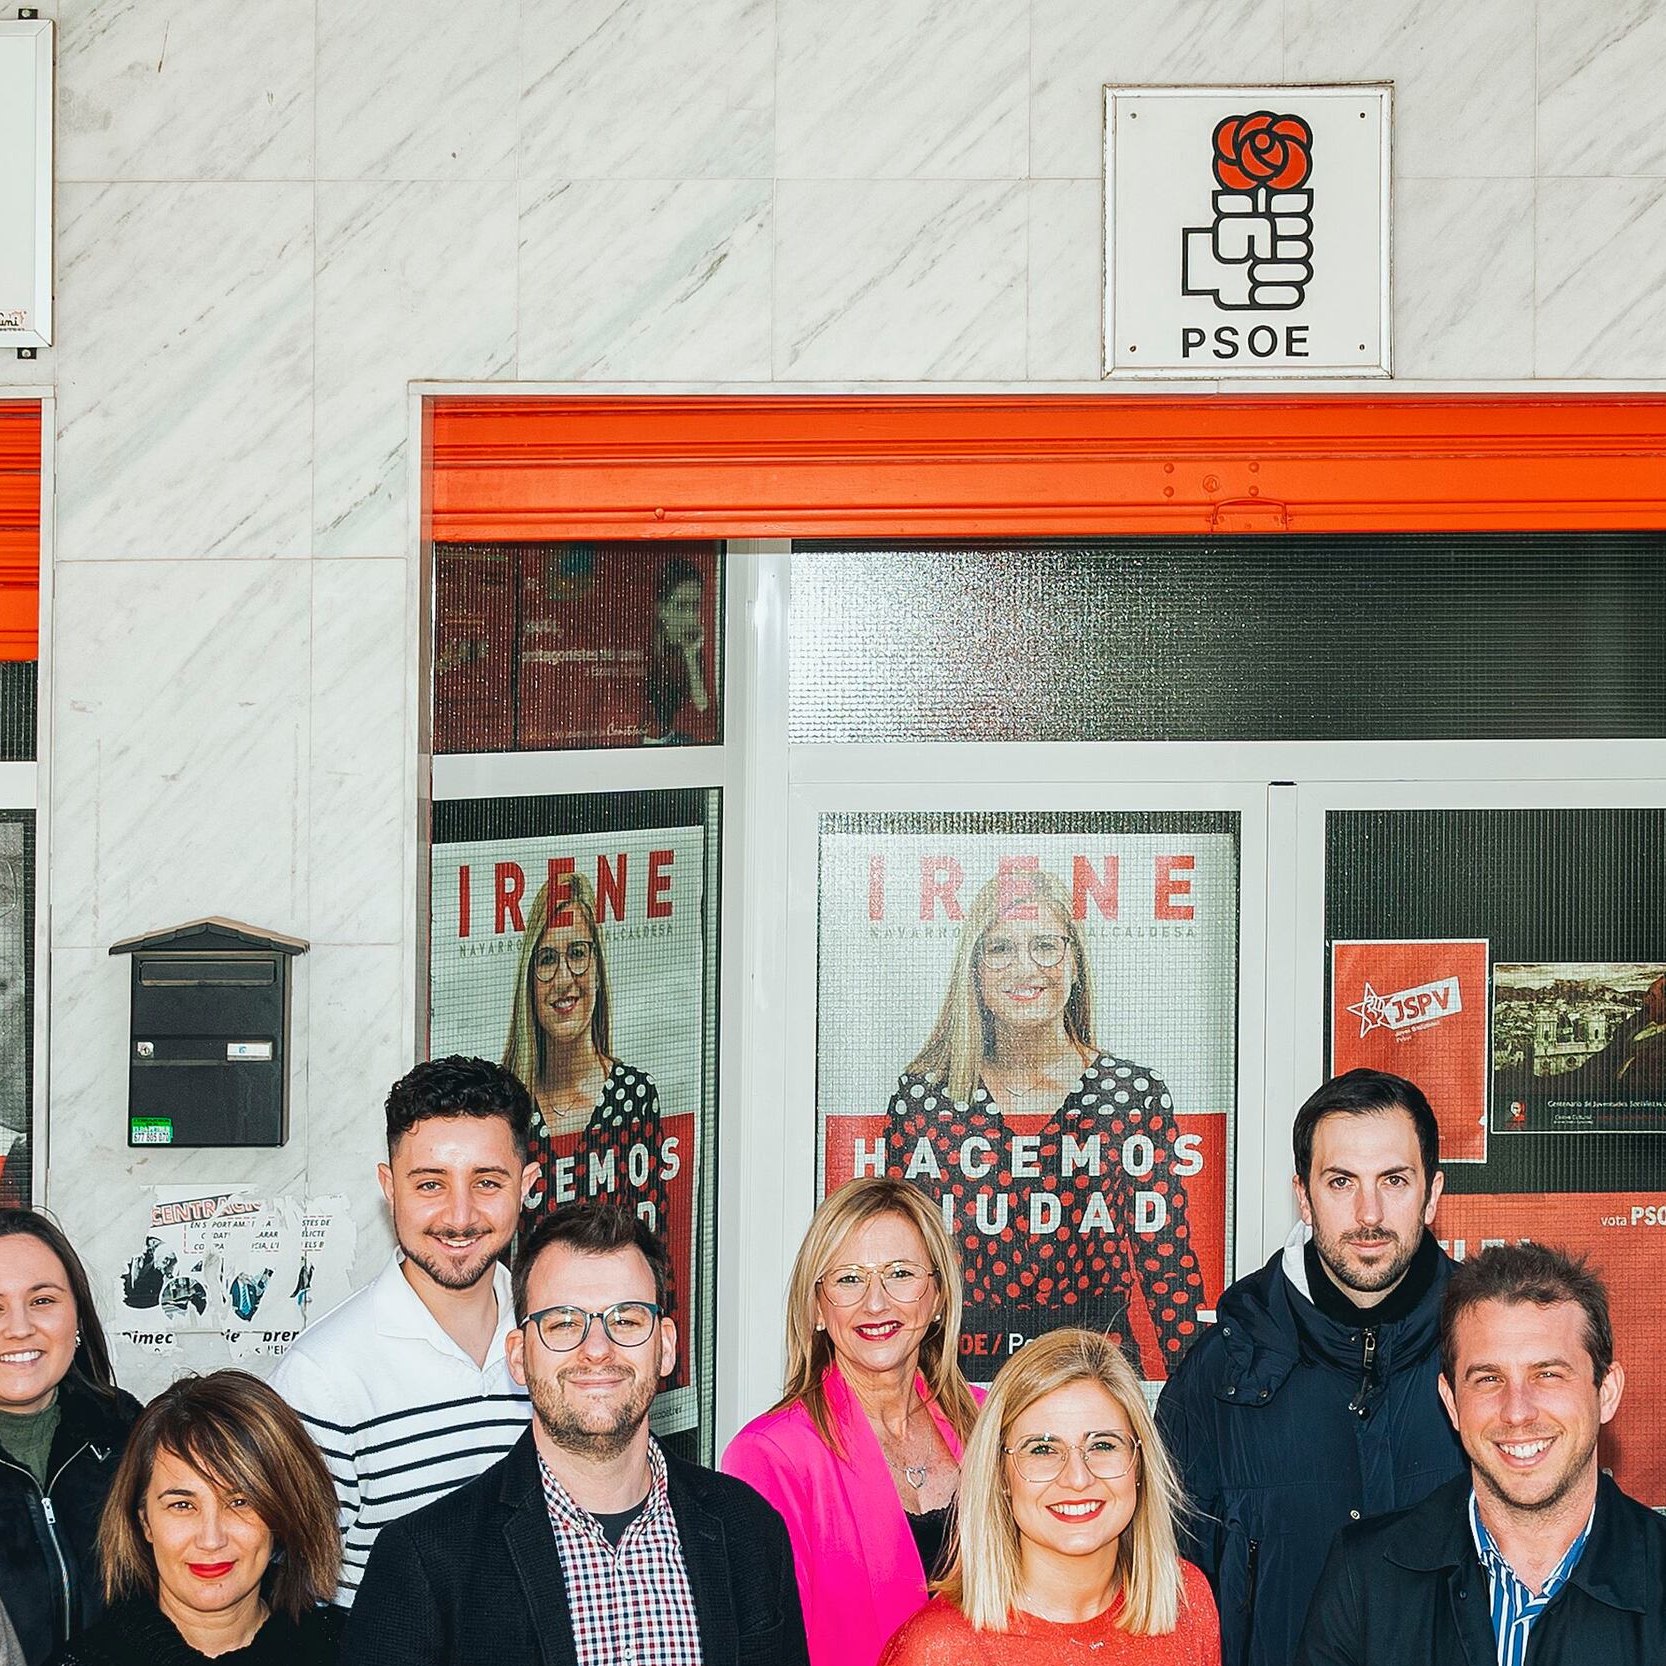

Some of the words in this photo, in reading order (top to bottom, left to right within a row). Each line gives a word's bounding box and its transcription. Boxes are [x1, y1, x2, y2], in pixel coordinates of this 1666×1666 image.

[1181, 325, 1310, 358] PSOE
[458, 850, 675, 938] IRENE
[868, 855, 1196, 922] IRENE
[459, 938, 523, 958] NAVARRO
[1393, 987, 1450, 1022] JSPV
[853, 1134, 1205, 1181] HACEMOS
[943, 1190, 1169, 1237] IUDAD
[1600, 1216, 1628, 1227] vota
